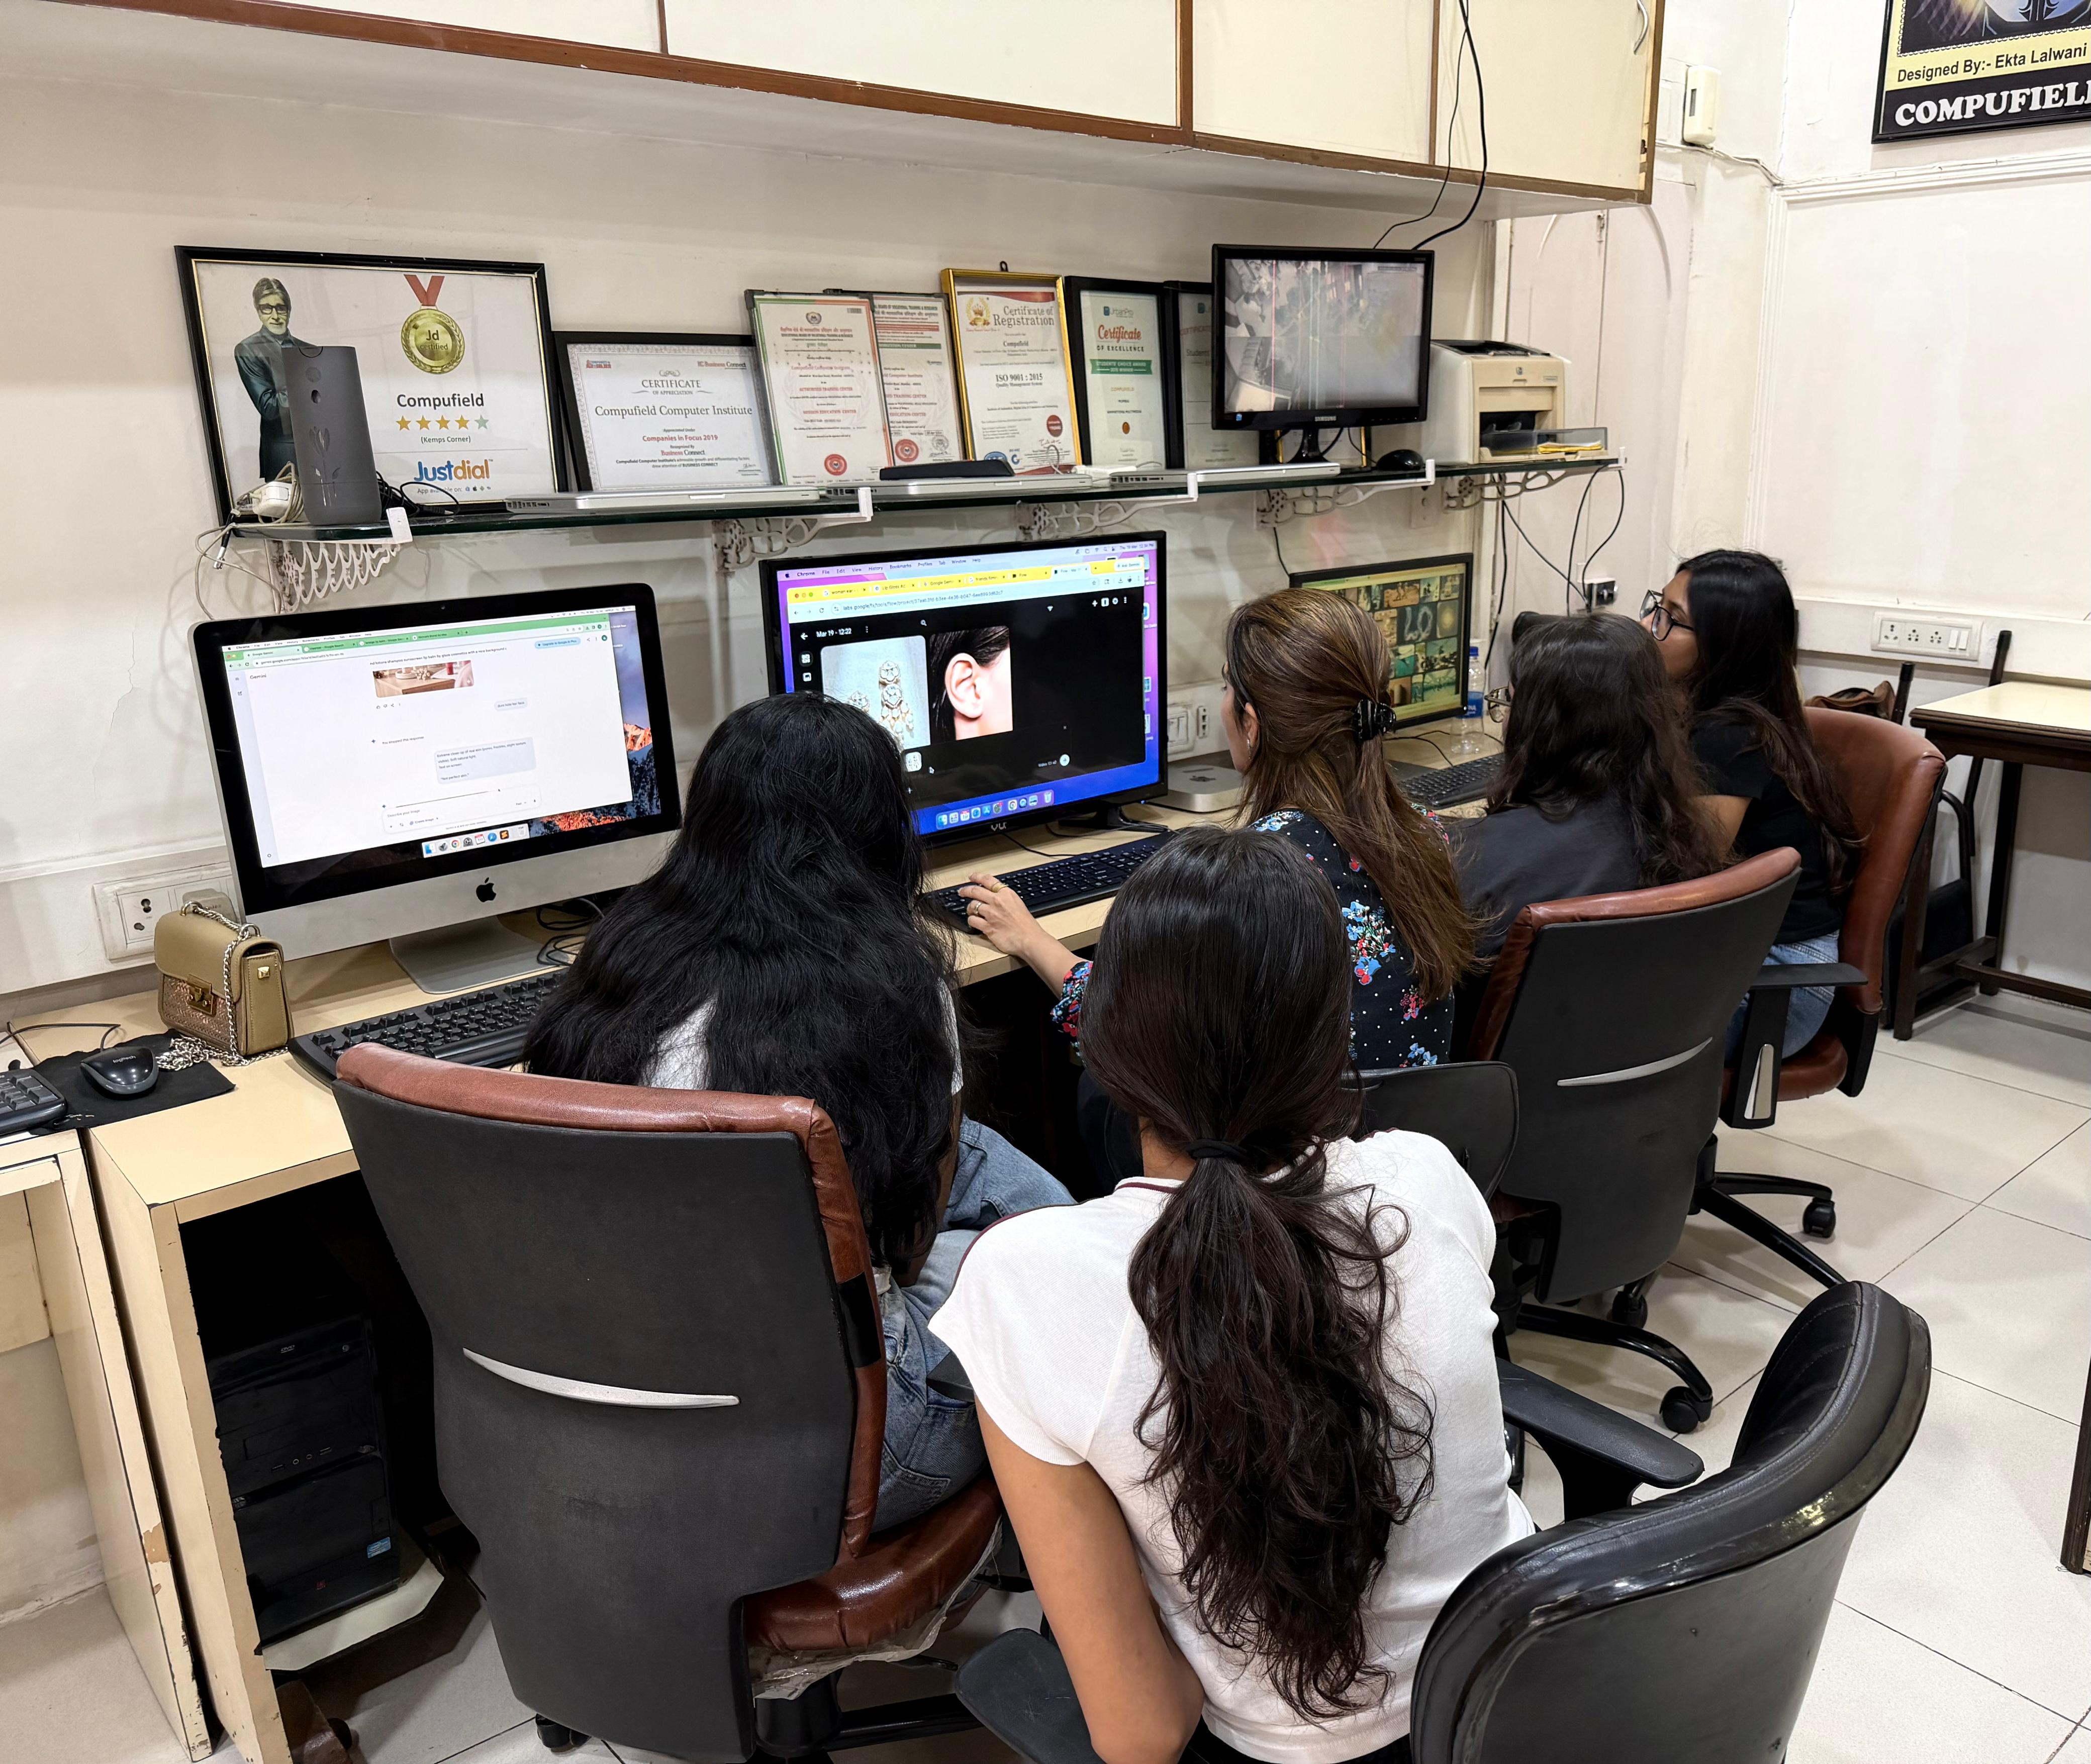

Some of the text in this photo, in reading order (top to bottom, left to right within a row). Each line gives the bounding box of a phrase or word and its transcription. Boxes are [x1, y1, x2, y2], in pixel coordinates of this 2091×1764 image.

[1897, 43, 2087, 82] Designed By:- Ekta Lalwani
[1004, 306, 1054, 316] Certificate of
[993, 314, 1055, 328] Registration
[426, 330, 439, 341] Jd
[1098, 325, 1142, 343] Certificate
[641, 379, 701, 388] CERTIFICATE
[397, 393, 485, 410] Compufield
[595, 406, 752, 419] Compufield Computer Institute
[421, 436, 445, 444] (Kemps
[414, 459, 490, 481] Justdial
[816, 630, 827, 638] Mar
